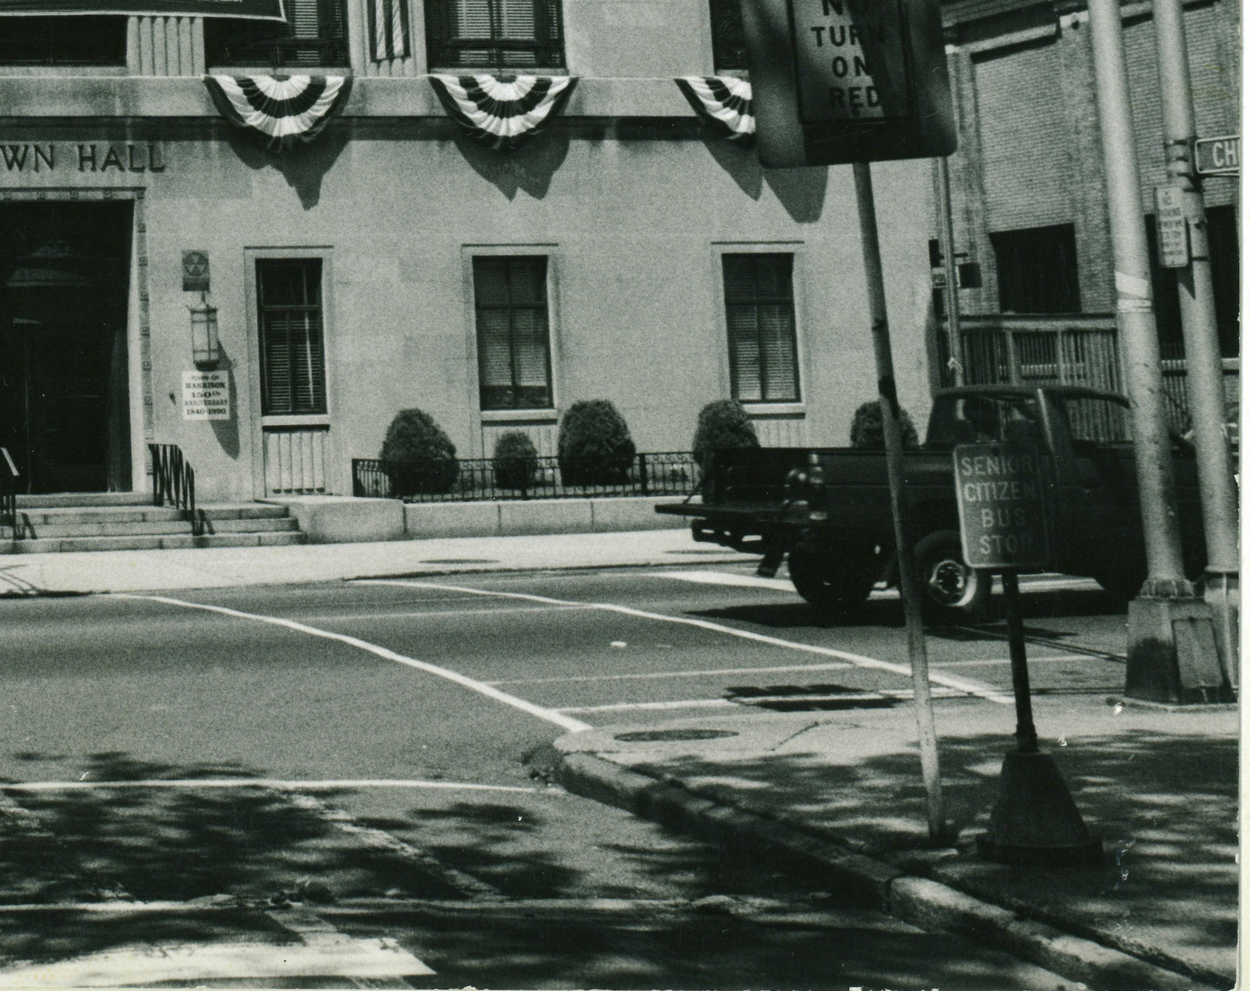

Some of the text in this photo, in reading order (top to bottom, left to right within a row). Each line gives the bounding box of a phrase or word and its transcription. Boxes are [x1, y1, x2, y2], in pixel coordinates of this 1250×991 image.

[810, 25, 885, 47] TURN
[832, 56, 871, 79] ON
[828, 86, 881, 109] RED
[78, 144, 165, 173] HALL
[1213, 140, 1240, 167] CH
[961, 455, 1034, 477] SENIOR
[963, 481, 1037, 504] CITIZEN
[980, 507, 1026, 529] BUS
[979, 534, 1033, 556] STOP
